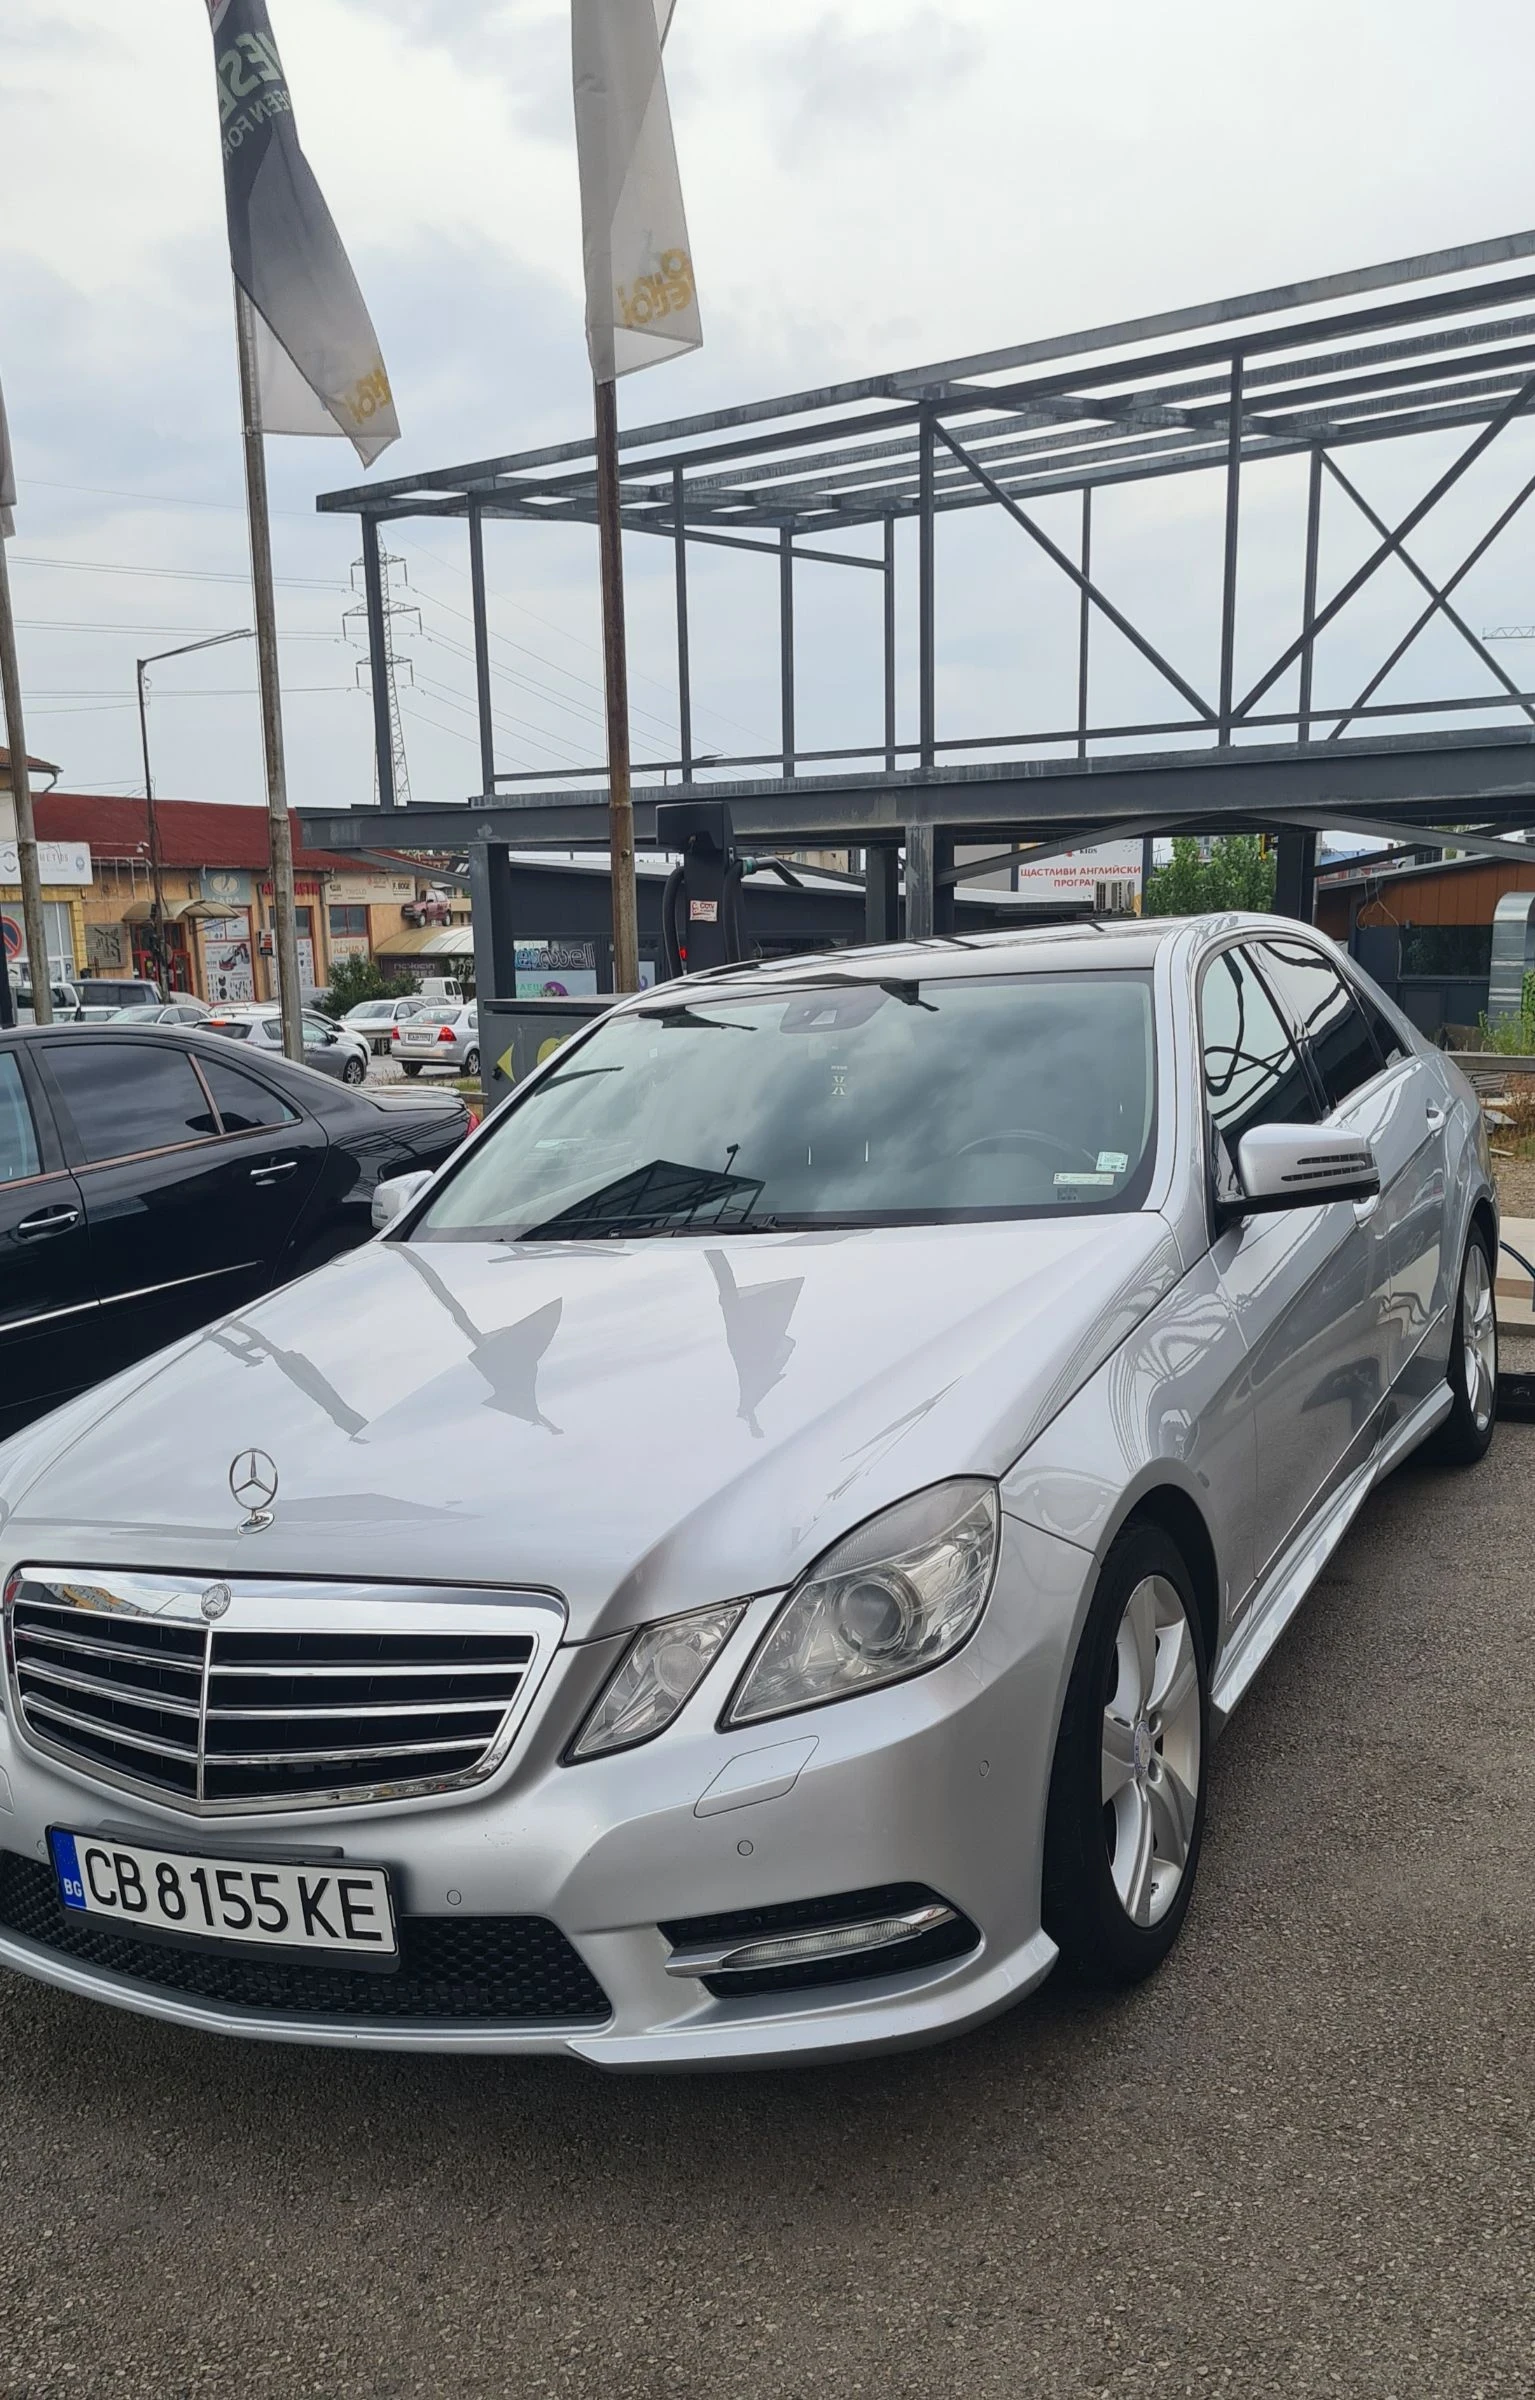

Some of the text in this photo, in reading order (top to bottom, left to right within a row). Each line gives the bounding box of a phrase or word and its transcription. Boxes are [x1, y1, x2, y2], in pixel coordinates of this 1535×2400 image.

[1079, 847, 1098, 855] KIDS
[1020, 864, 1141, 878] ЩАСТЛИВИ АНГЛИЙСКИ
[63, 1877, 83, 1898] BG
[84, 1847, 384, 1942] CB 8155 KE
